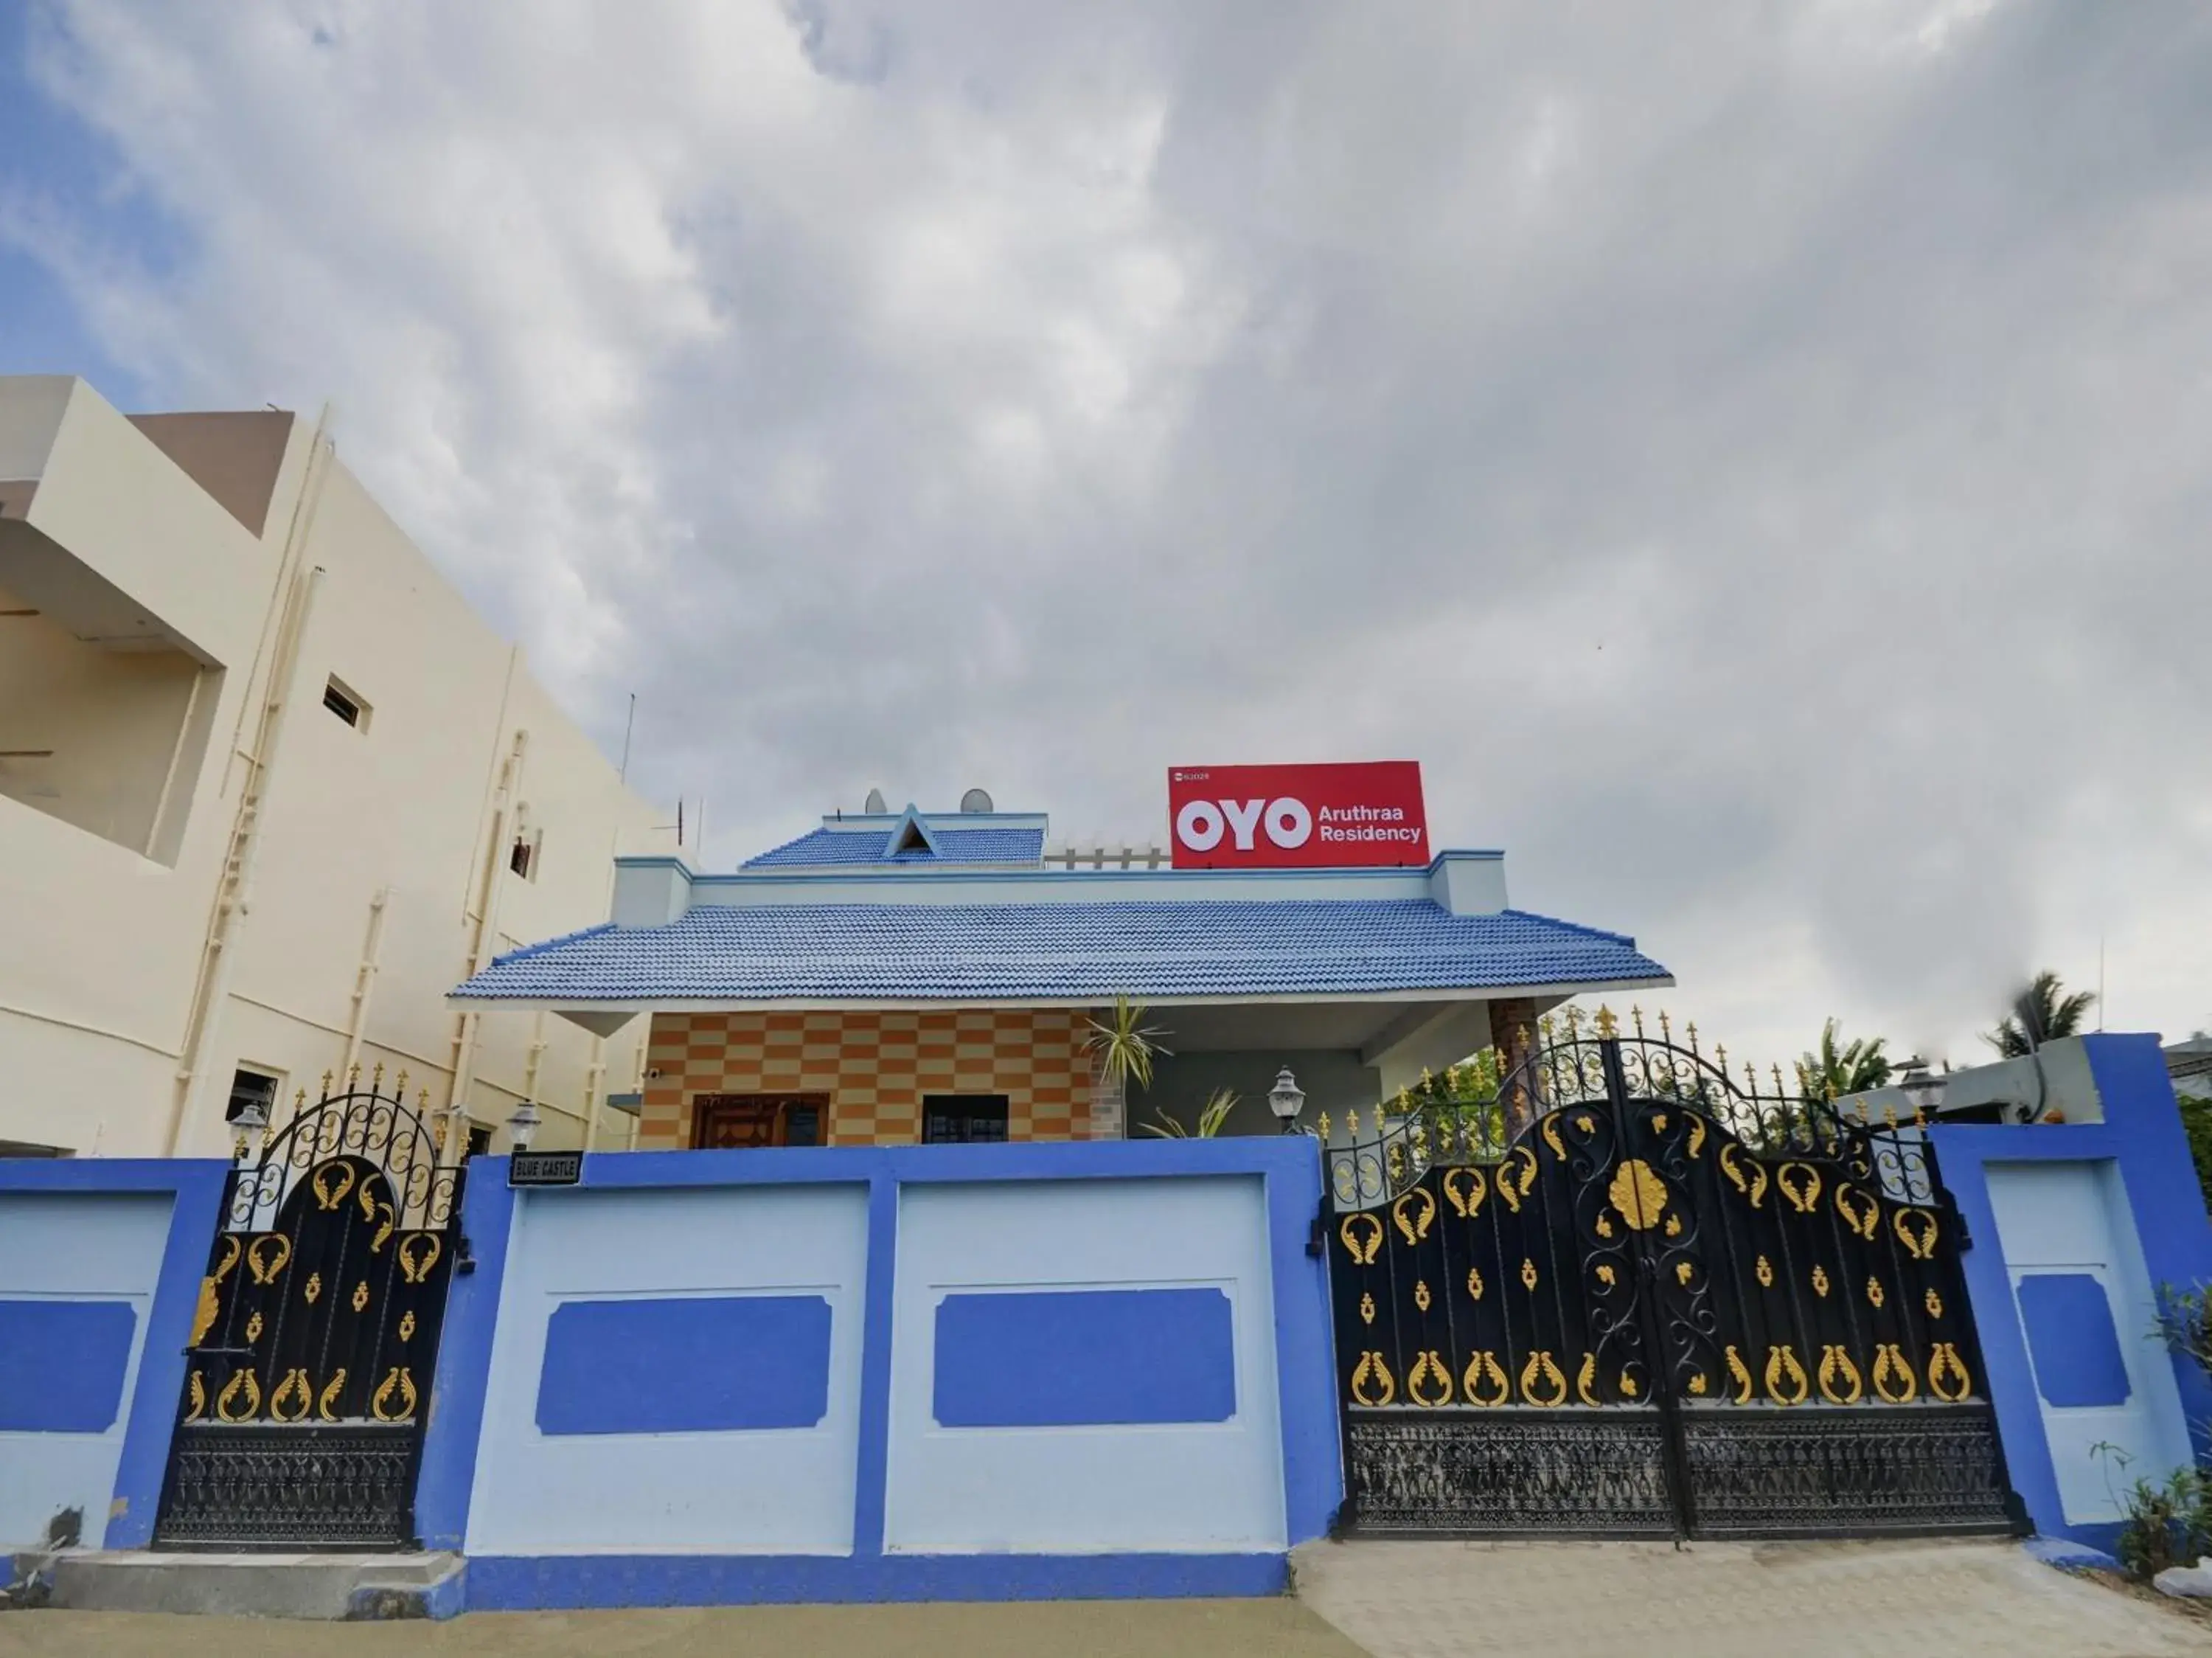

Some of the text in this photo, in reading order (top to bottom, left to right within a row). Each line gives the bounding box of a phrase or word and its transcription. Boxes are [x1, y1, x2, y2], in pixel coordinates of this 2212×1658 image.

[1319, 805, 1403, 822] Aruthraa
[1177, 797, 1312, 851] OYO
[1321, 825, 1422, 844] Residency
[515, 1160, 576, 1176] BLUE CASTLE
